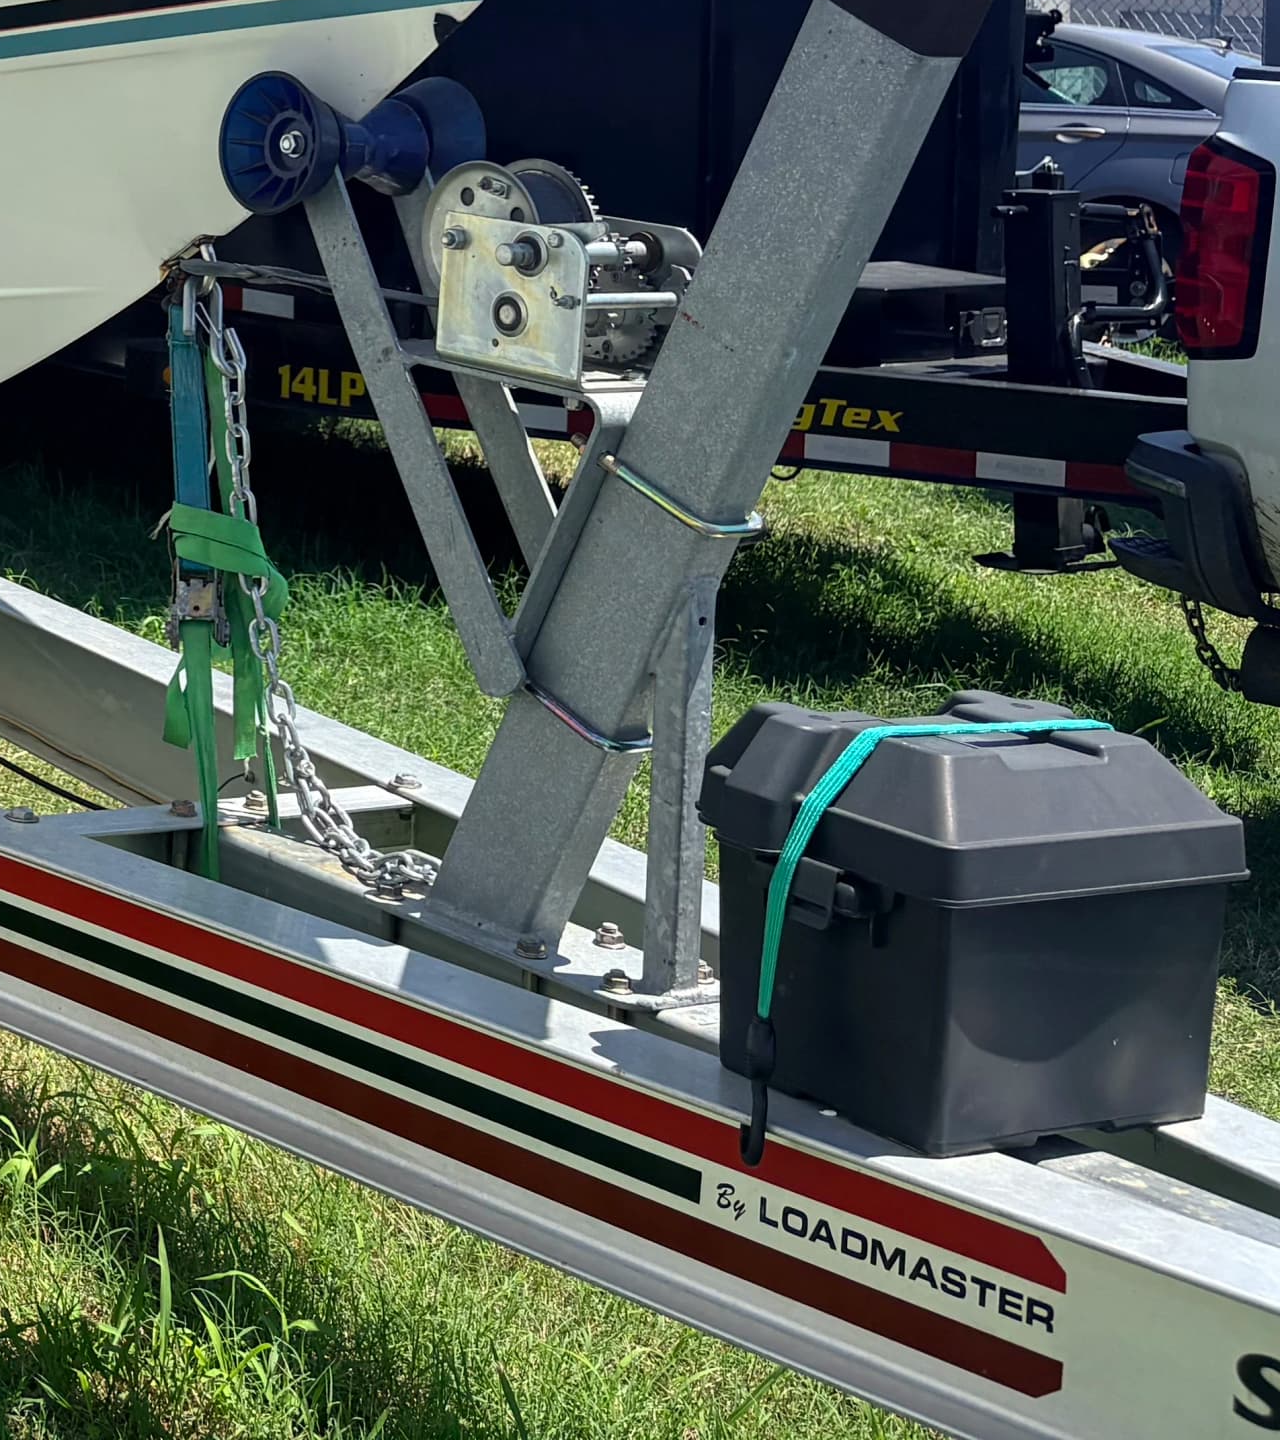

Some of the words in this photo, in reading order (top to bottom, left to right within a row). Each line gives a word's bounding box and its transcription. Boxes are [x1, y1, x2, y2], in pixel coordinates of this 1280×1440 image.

[278, 364, 366, 407] 14LP
[792, 398, 903, 432] gTex
[716, 1183, 746, 1221] By
[759, 1196, 1055, 1333] LOADMASTER
